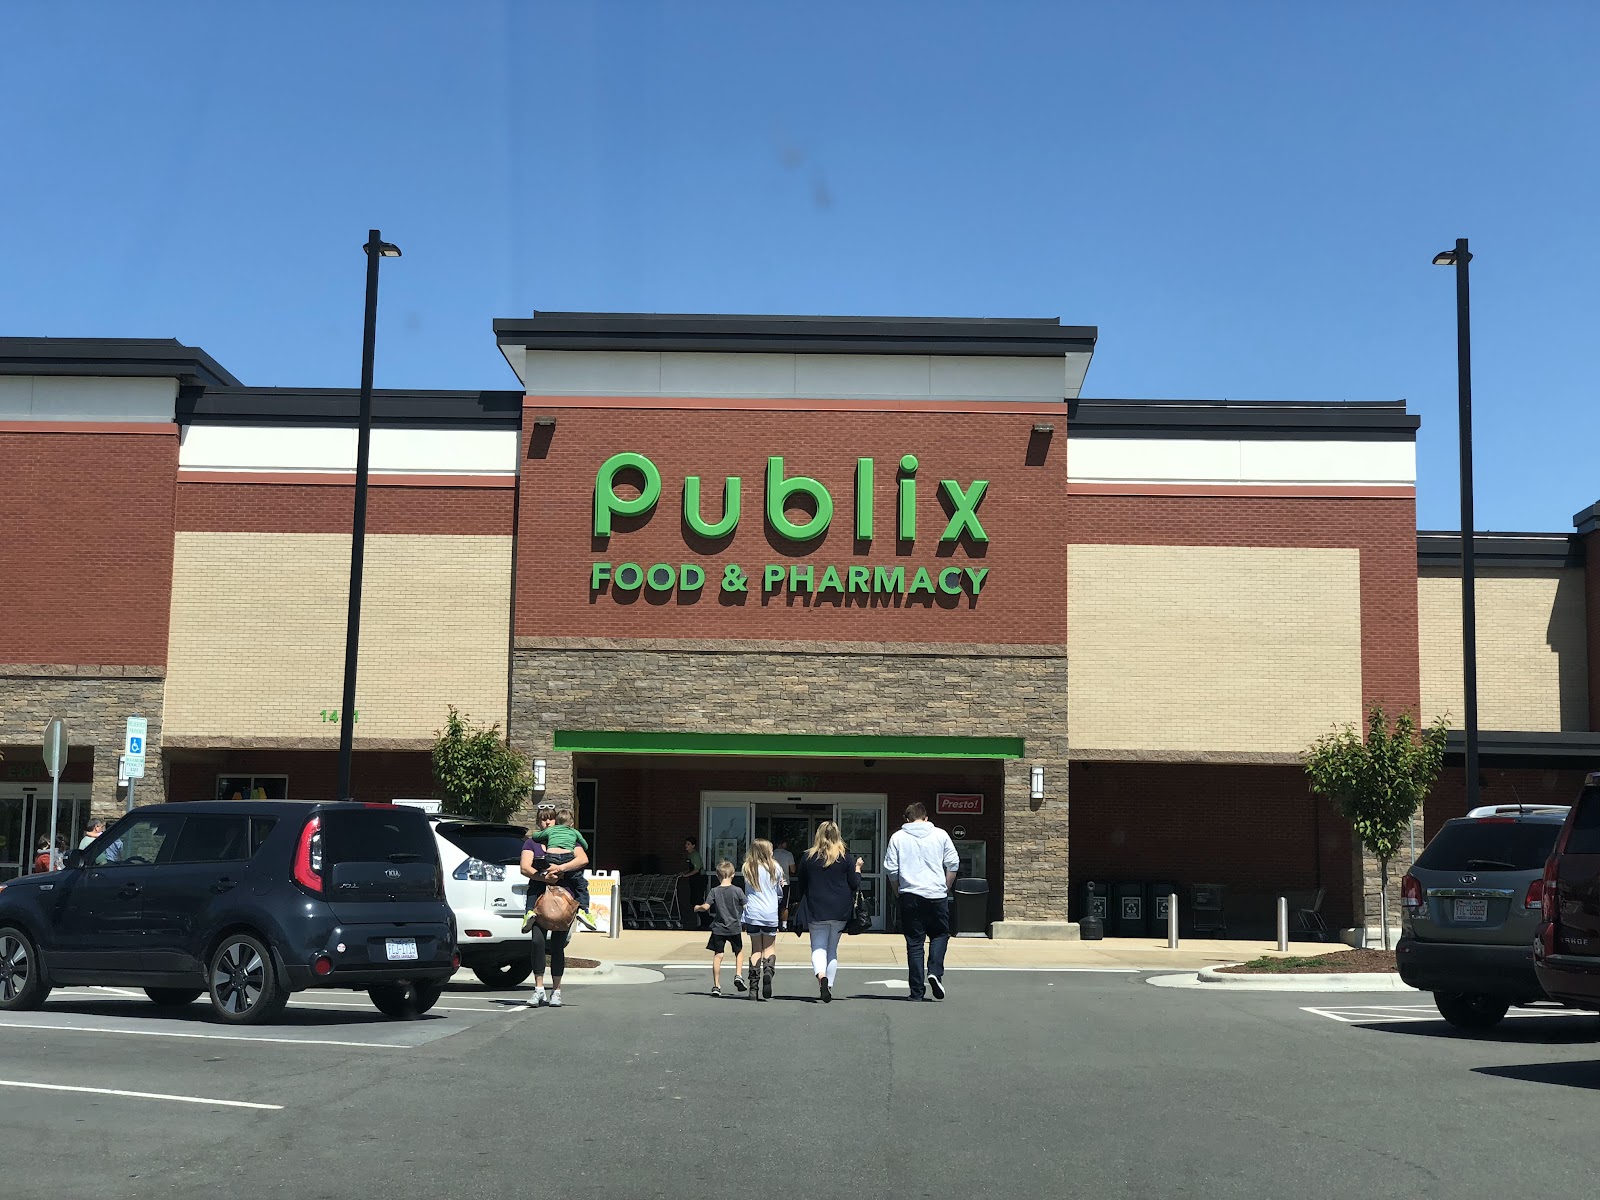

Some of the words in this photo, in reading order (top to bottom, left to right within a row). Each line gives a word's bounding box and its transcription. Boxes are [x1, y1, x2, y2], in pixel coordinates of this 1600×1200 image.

[594, 452, 990, 542] Publix
[592, 562, 705, 592] FOOD
[721, 564, 748, 593] &
[764, 564, 990, 595] PHARMACY
[320, 710, 359, 723] 141
[768, 775, 819, 788] ENTRY
[942, 799, 979, 809] Presto!
